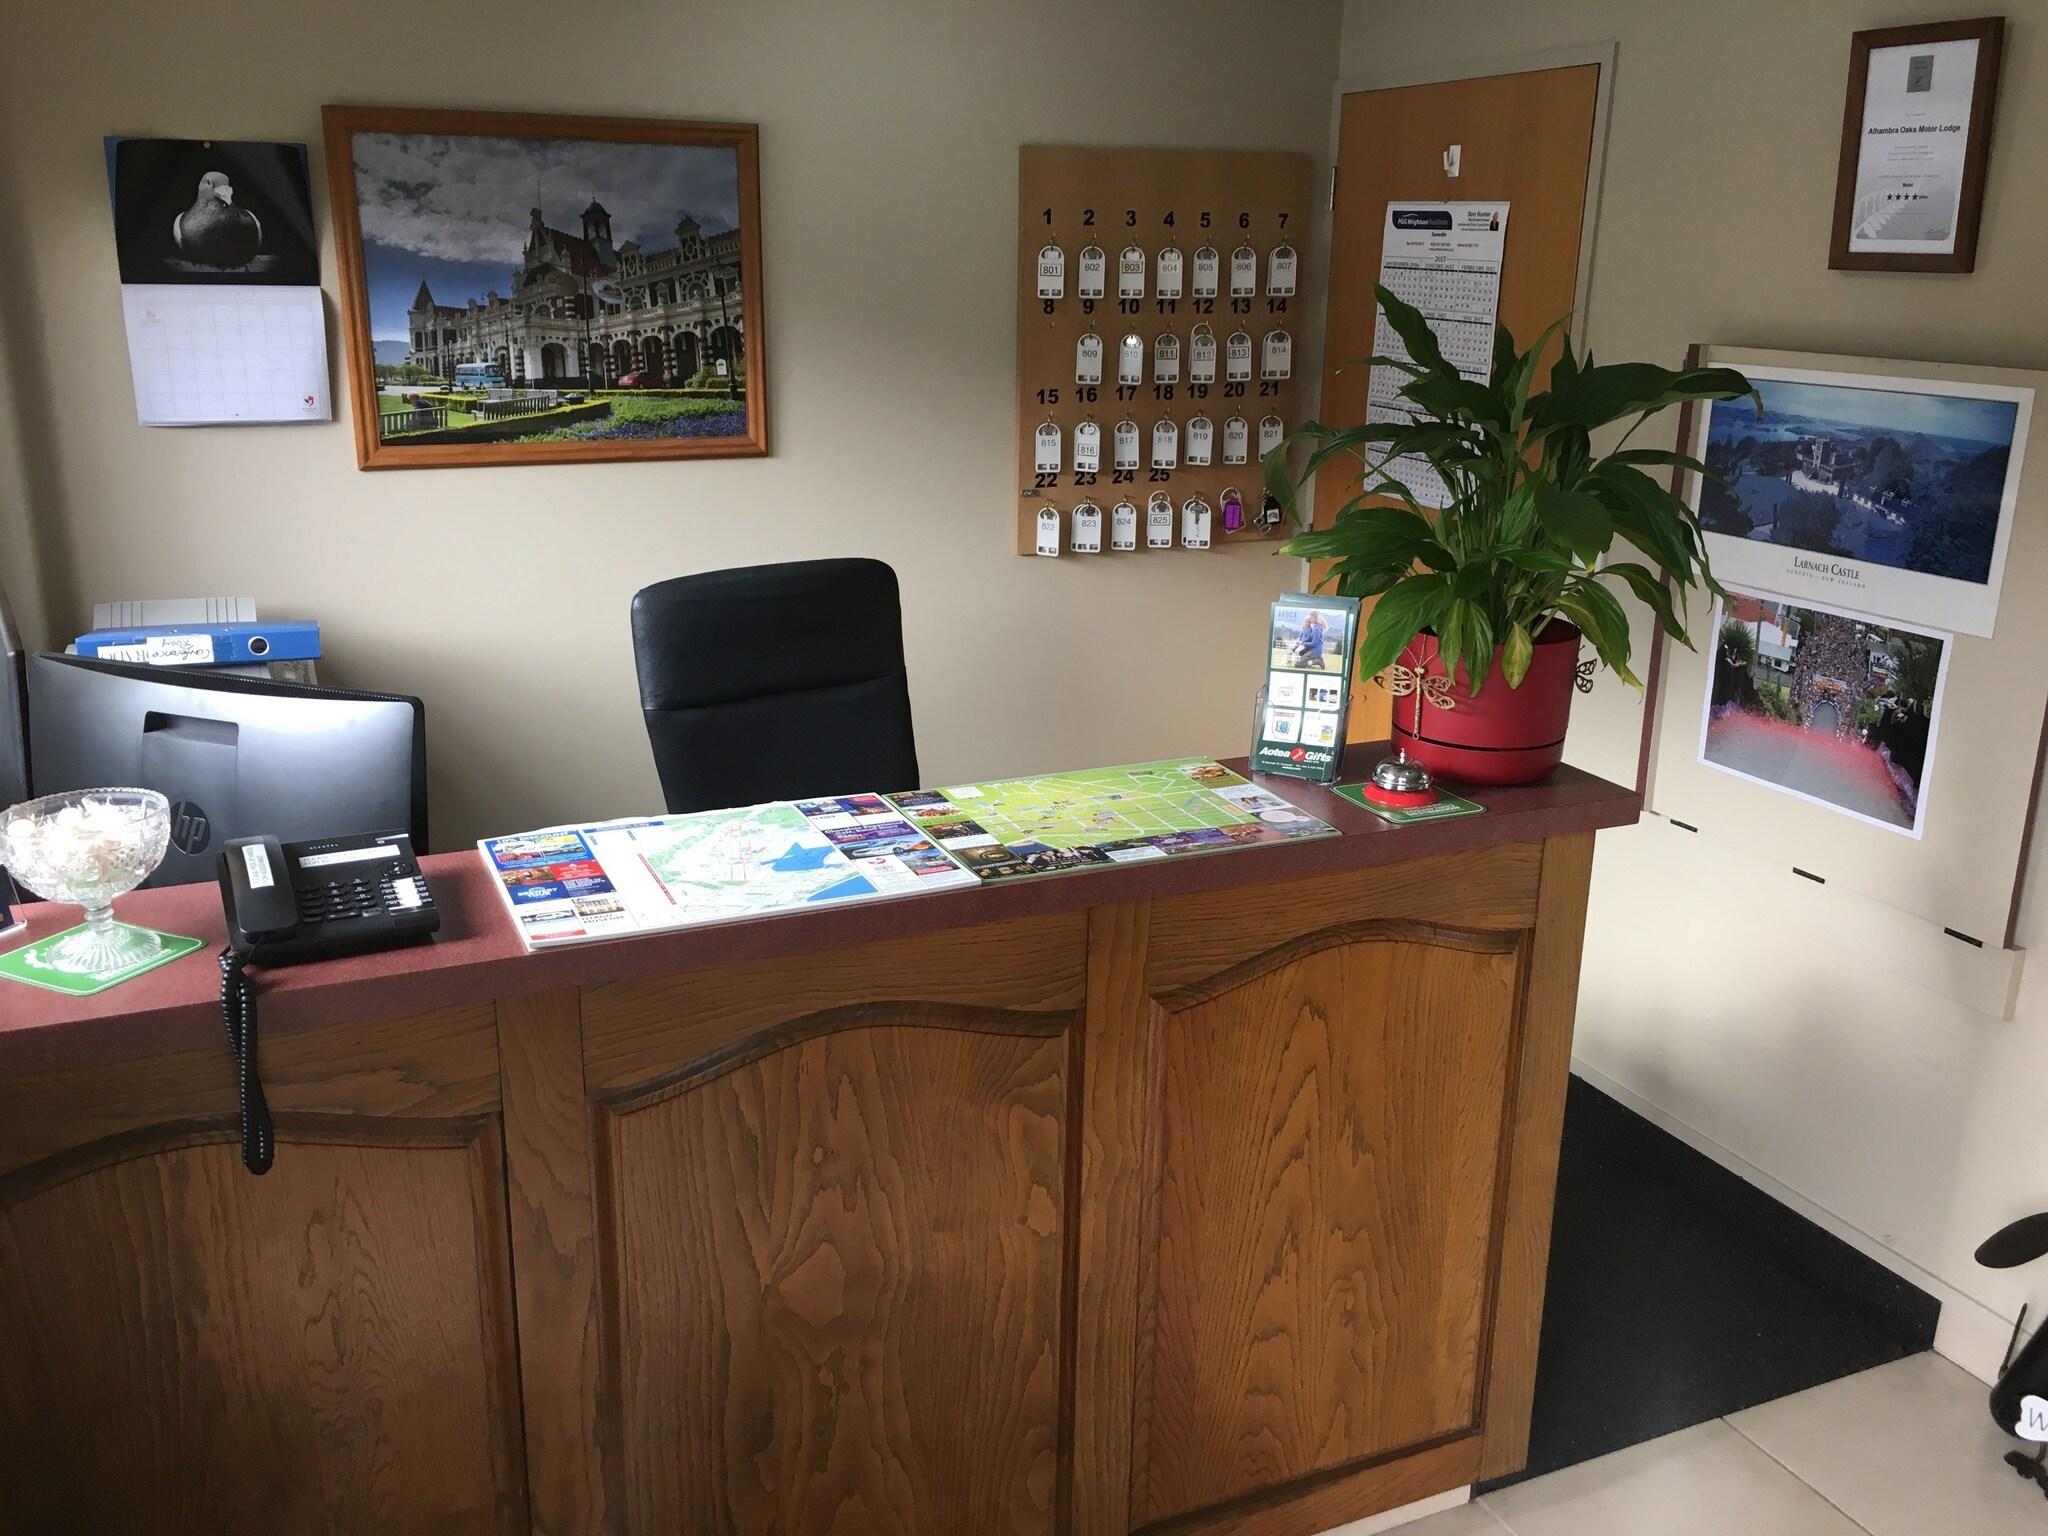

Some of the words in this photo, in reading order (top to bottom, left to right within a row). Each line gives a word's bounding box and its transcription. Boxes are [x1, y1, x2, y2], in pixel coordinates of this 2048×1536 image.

[1868, 127, 1899, 135] Alhambra
[1919, 125, 1938, 133] Motor
[1939, 125, 1961, 133] Lodge
[1043, 208, 1052, 225] 1
[1083, 209, 1095, 226] 2
[1125, 210, 1137, 227] 3
[1163, 211, 1175, 228] 4
[1200, 212, 1211, 228] 5
[1239, 213, 1250, 229] 6
[1278, 213, 1289, 229] 7
[1043, 265, 1058, 274] 801
[1084, 263, 1100, 271] 802
[1124, 263, 1141, 271] 803
[1198, 263, 1213, 271] 805
[1043, 299, 1055, 314] 8
[1083, 299, 1095, 314] 9
[1118, 299, 1140, 314] 10
[1156, 299, 1176, 314] 11
[1192, 299, 1214, 314] 12
[1230, 299, 1251, 314] 13
[1266, 299, 1288, 314] 14
[1082, 350, 1098, 358] 809
[1160, 350, 1175, 358] 811
[1231, 349, 1247, 357] 813
[1036, 389, 1059, 404] 15
[1075, 387, 1098, 403] 16
[1115, 386, 1137, 401] 17
[1153, 385, 1174, 401] 18
[1187, 384, 1208, 399] 19
[1224, 382, 1246, 397] 20
[1259, 382, 1280, 396] 21
[1264, 430, 1278, 438] 821
[1041, 439, 1057, 447] 815
[1080, 446, 1095, 454] 816
[1035, 472, 1058, 488] 22
[1074, 471, 1097, 486] 23
[1112, 469, 1135, 484] 24
[1148, 468, 1170, 482] 25
[1152, 516, 1168, 524] 825
[1259, 746, 1291, 758] Aotea
[1305, 751, 1333, 763] Gifts
